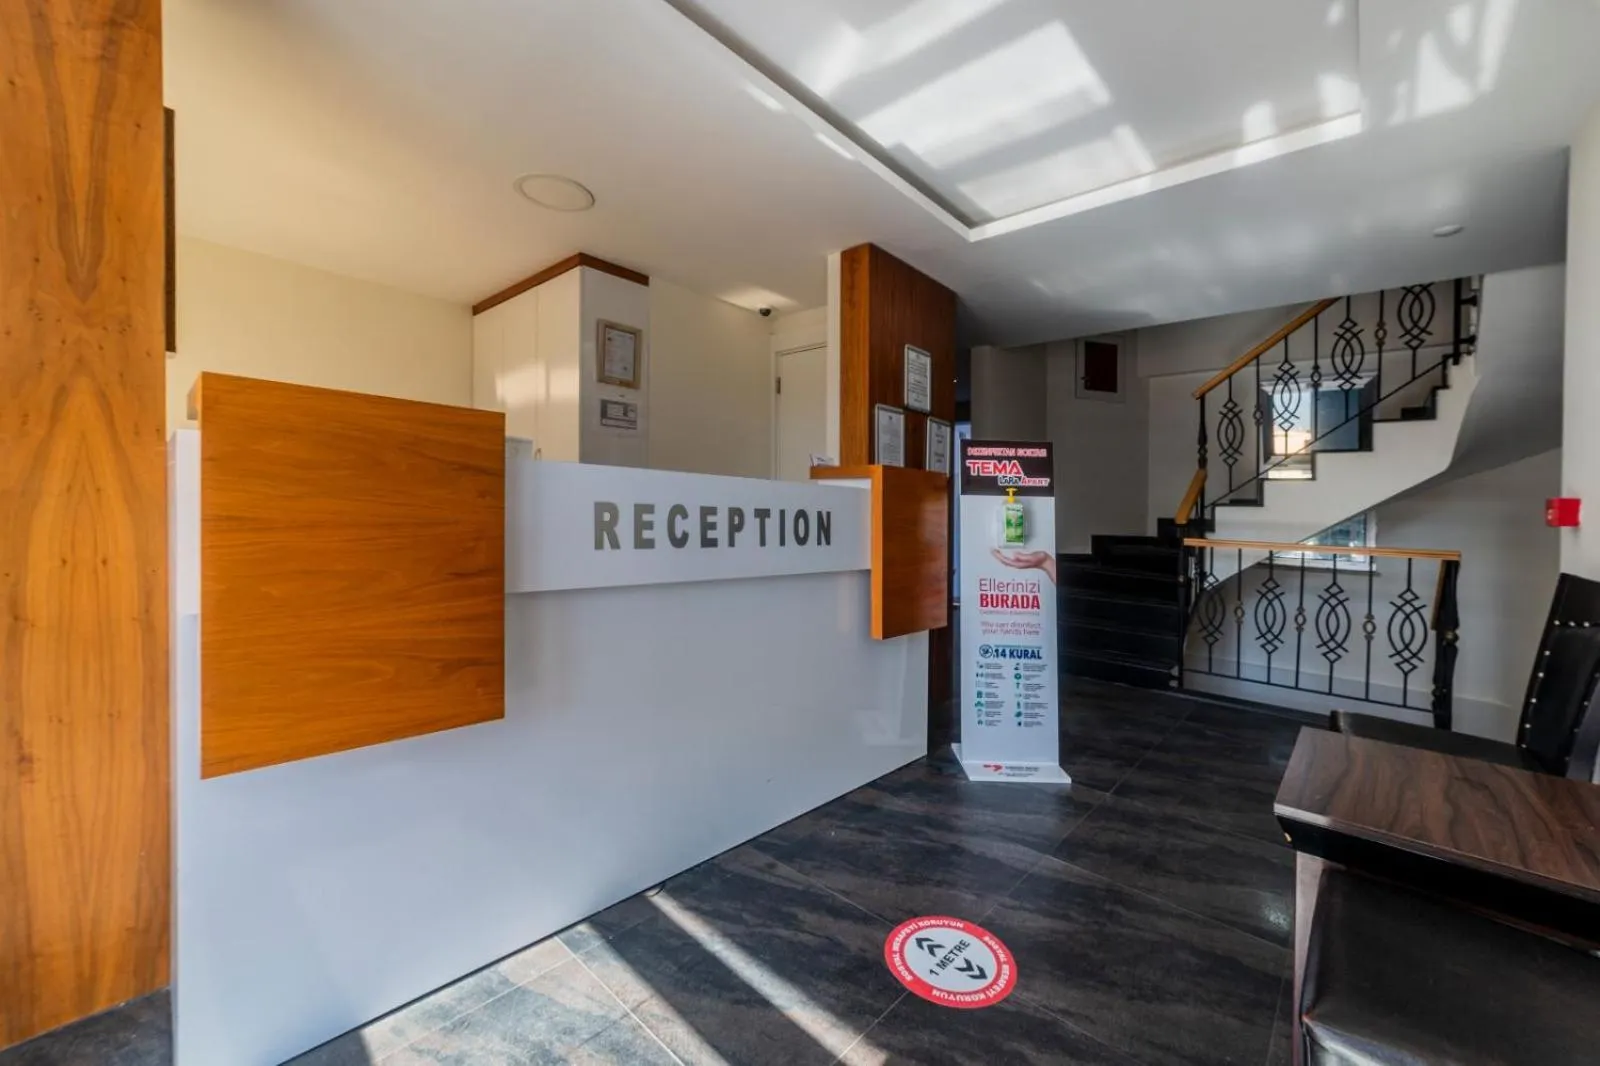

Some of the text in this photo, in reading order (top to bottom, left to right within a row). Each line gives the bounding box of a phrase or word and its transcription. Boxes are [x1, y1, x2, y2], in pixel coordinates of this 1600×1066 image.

[966, 460, 1023, 476] TEMA
[594, 501, 832, 551] RECEPTION
[979, 577, 1040, 593] Ellerinizi
[980, 593, 1041, 609] BURADA
[1009, 649, 1042, 660] KURAL
[919, 919, 964, 928] KORUYUN
[929, 939, 971, 977] 1 METRE
[932, 989, 987, 1002] KORUYUN
